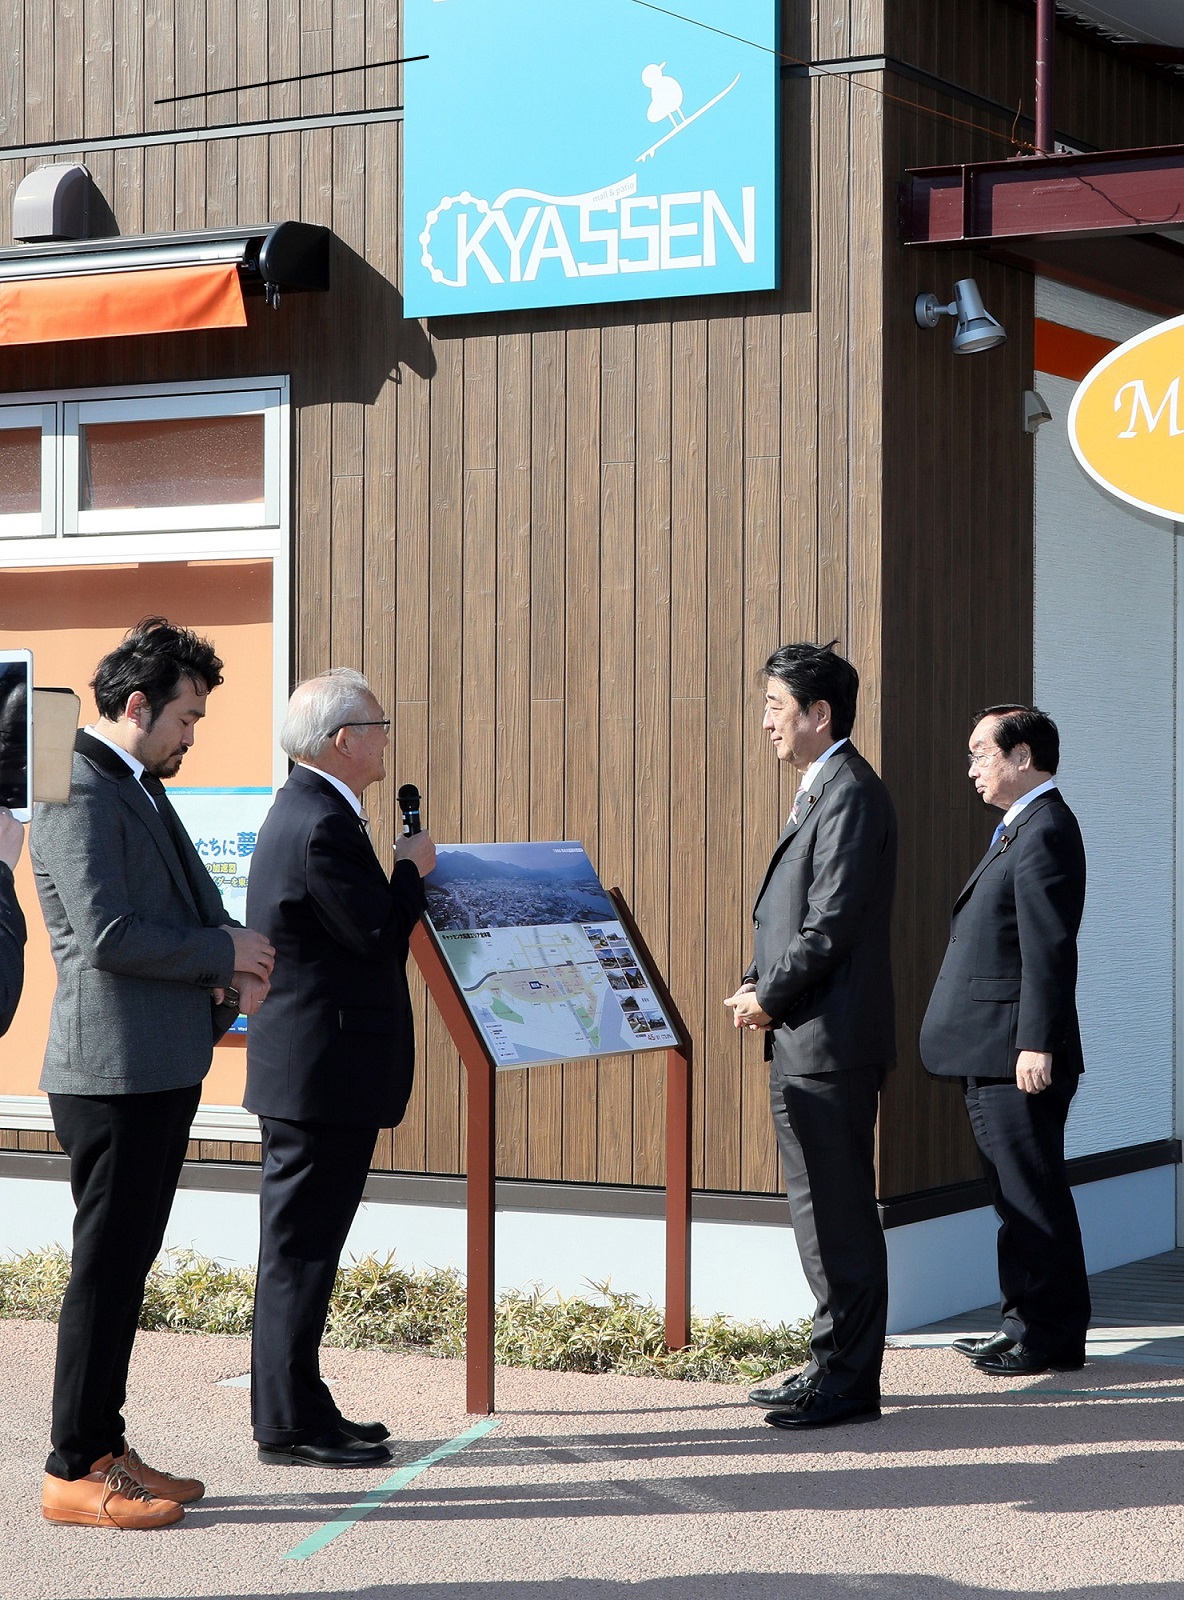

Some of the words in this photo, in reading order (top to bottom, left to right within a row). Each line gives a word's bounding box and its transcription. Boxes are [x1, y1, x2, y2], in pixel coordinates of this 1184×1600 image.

[592, 190, 609, 202] mall
[609, 188, 615, 197] &
[615, 182, 634, 196] patio
[456, 186, 756, 287] KYASSEN
